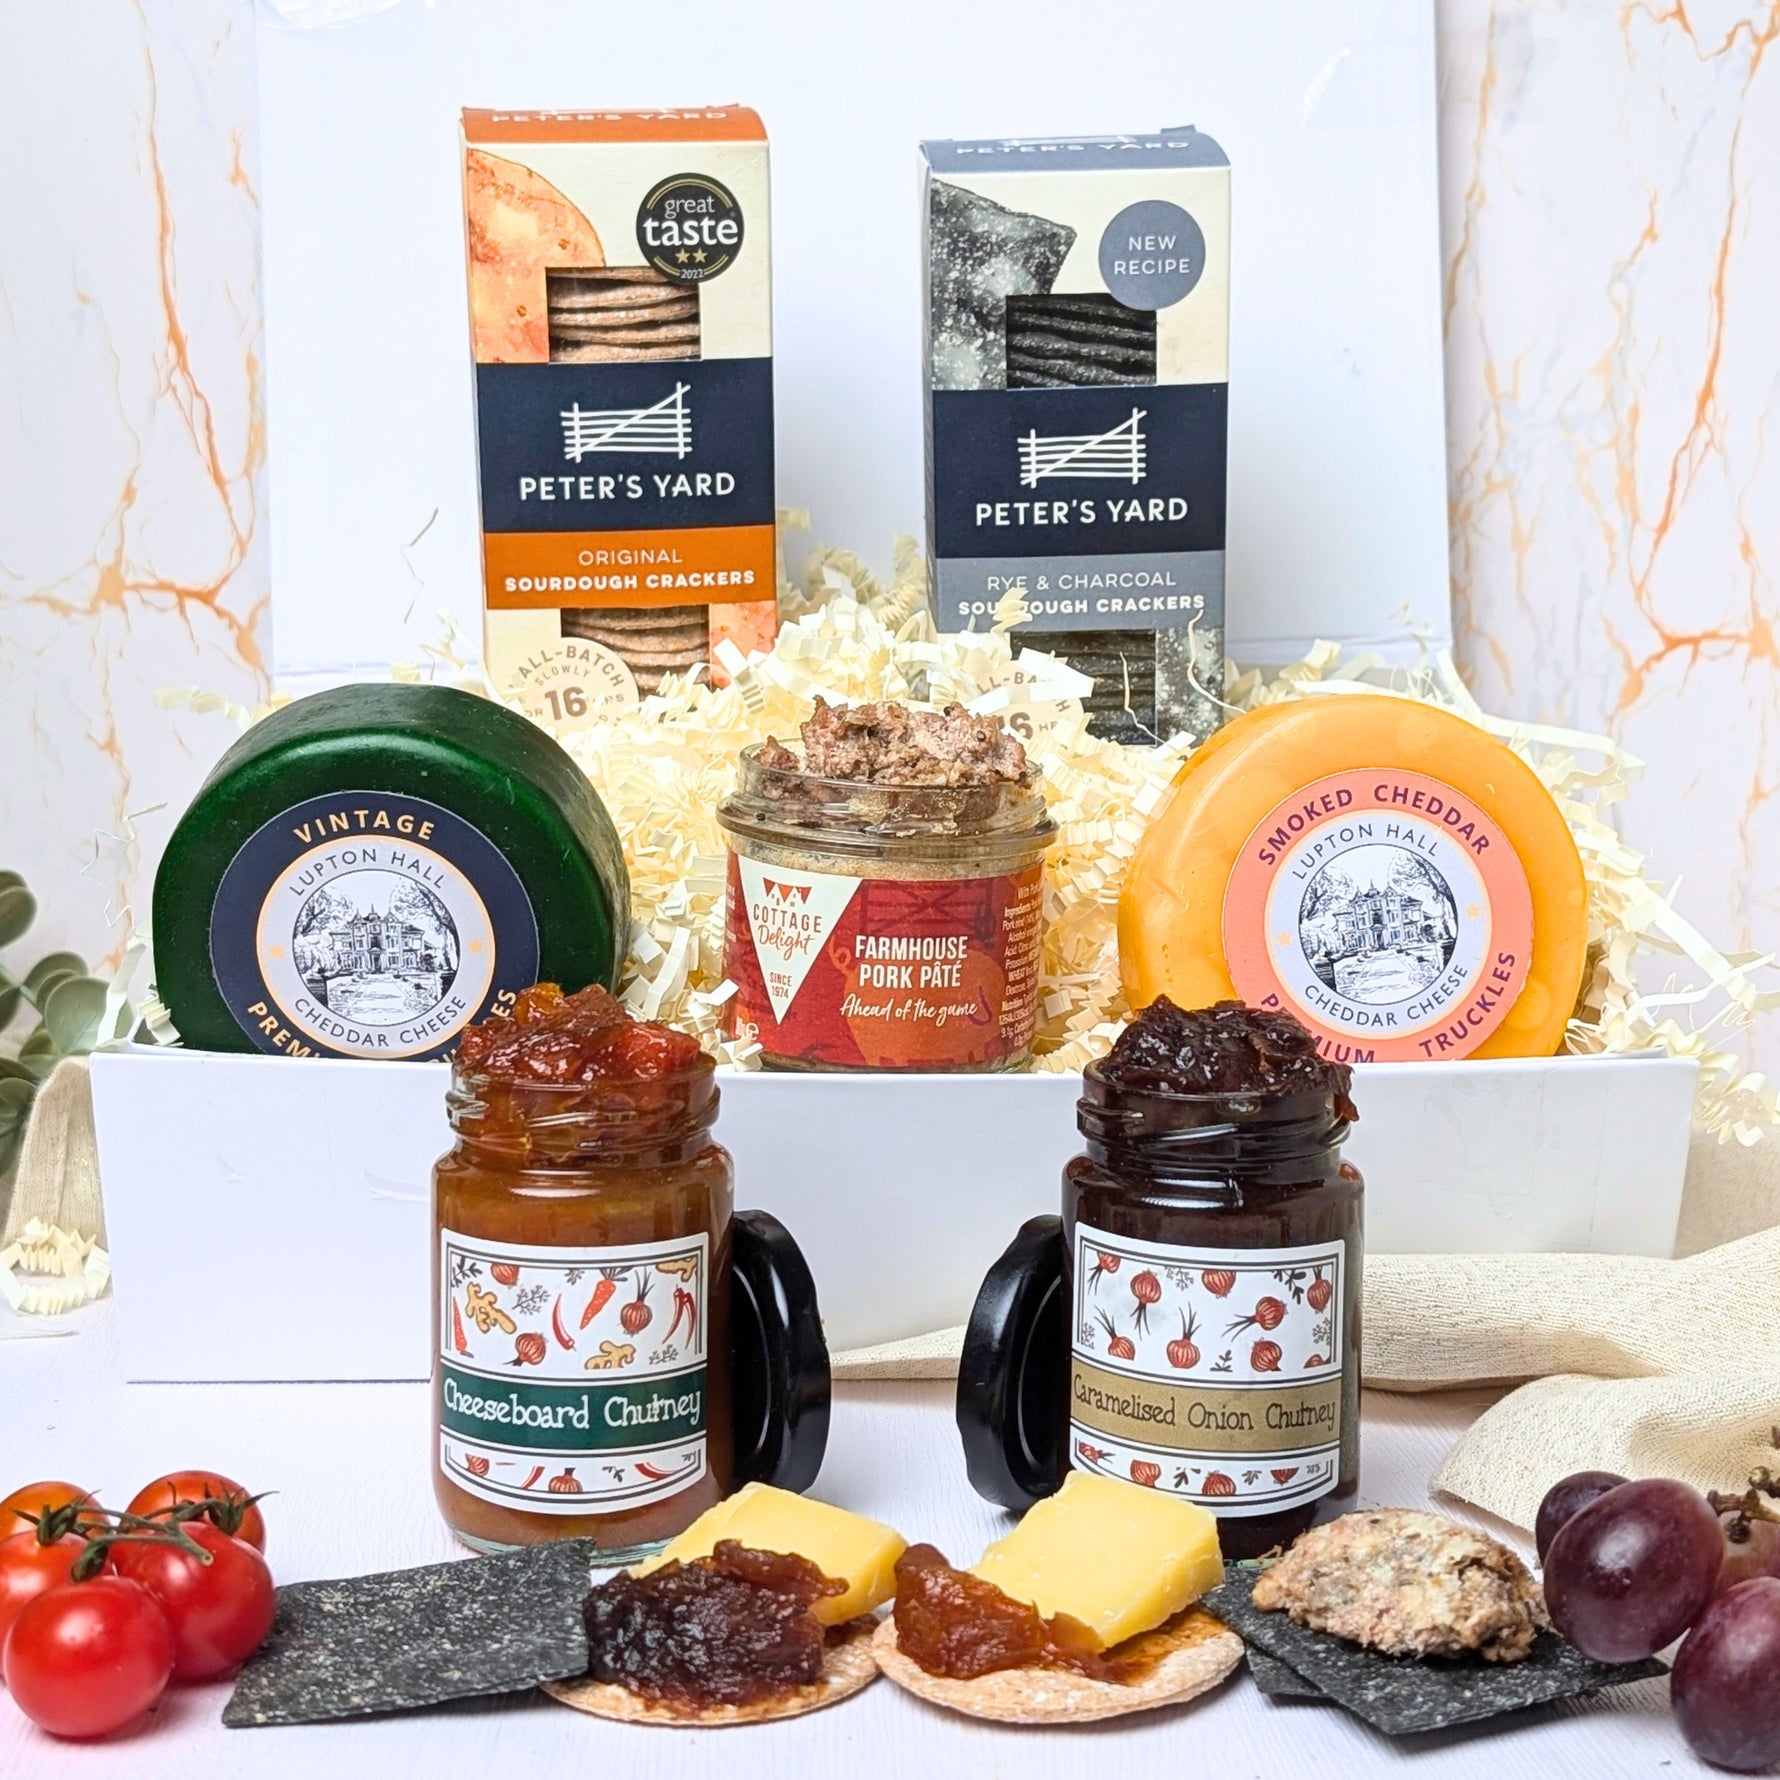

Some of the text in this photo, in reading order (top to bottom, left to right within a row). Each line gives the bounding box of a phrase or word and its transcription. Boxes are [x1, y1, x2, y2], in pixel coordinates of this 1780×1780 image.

[492, 111, 727, 122] PETER'S YARD
[956, 141, 1189, 155] PETER'S YARD
[664, 196, 715, 219] great
[642, 216, 739, 246] taste
[1127, 235, 1177, 251] NEW
[680, 268, 704, 279] 2022
[1114, 258, 1191, 275] RECIPE
[519, 472, 736, 501] PETER'S YARD
[975, 497, 1189, 526] PETER'S YARD
[578, 548, 683, 566] ORIGINAL
[505, 570, 755, 592] SOURDOUGH CRACKERS
[987, 571, 1177, 591] RYE & CHARCOAL
[959, 595, 1205, 616] SOUOUGH CRACKERS
[508, 645, 625, 689] ALL-BATCH
[534, 664, 591, 687] SLOWLY
[525, 707, 544, 718] OR
[544, 686, 588, 721] 16
[293, 809, 435, 844] VINTAGE
[1259, 784, 1491, 865] SMOKED CHEDDAR
[1292, 823, 1439, 880] LUPTON HALL
[289, 848, 443, 896] LUPTON HALL
[753, 903, 823, 933] COTTAGE
[756, 924, 815, 961] Delight
[855, 935, 969, 960] FARMHOUSE
[769, 972, 793, 987] SINCE
[859, 960, 962, 989] PORK PÂTÉ
[771, 985, 790, 999] 1974
[1304, 964, 1468, 1027] CHEDDAR CHEESE
[294, 998, 389, 1047] CHEDDAR
[400, 995, 467, 1044] CHEESE
[840, 993, 894, 1021] Ahead
[895, 999, 912, 1021] of
[936, 1003, 978, 1027] game
[1261, 952, 1516, 1063] PMIUM TRUCKLES
[247, 1001, 320, 1058] PREM
[444, 1378, 701, 1429] Cheeseboard Chutney
[1074, 1374, 1336, 1432] Caramelised Onion Chutney
